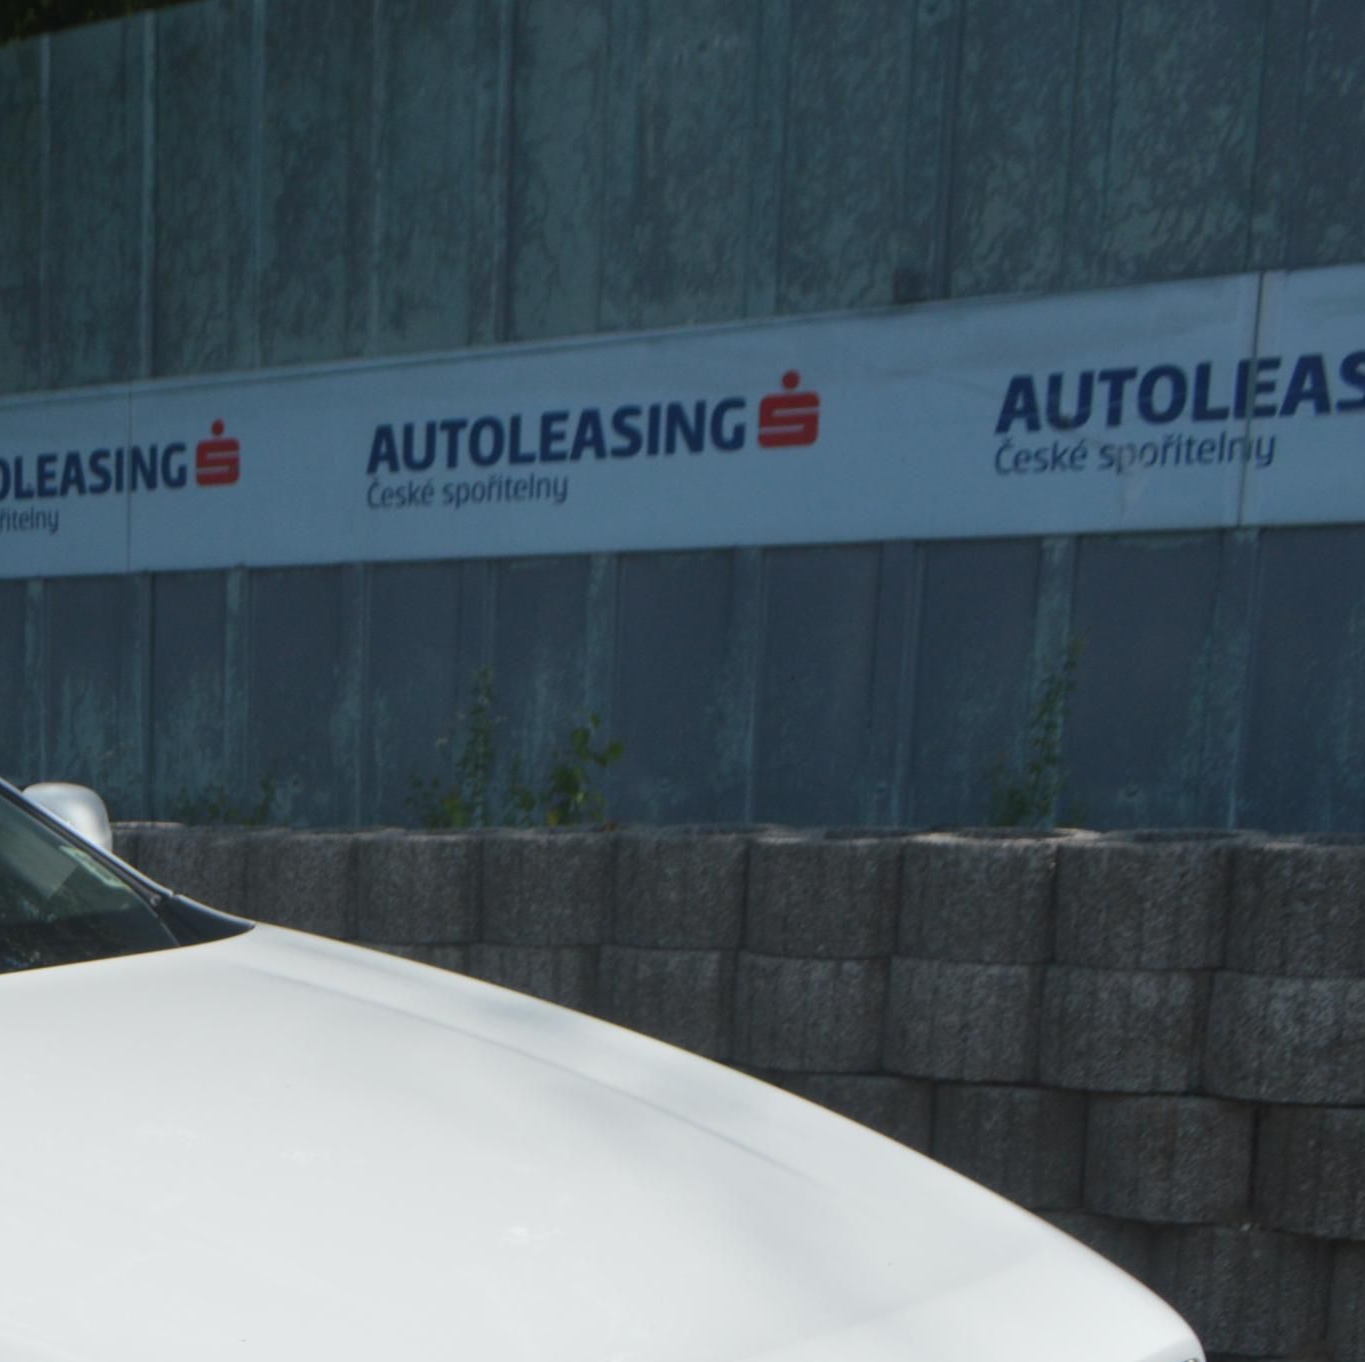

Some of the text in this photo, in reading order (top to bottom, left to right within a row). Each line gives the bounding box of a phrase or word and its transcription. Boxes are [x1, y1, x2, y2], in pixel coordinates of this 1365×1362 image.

[367, 397, 747, 475] AUTOLEASING
[995, 430, 1277, 476] České spořitelny
[367, 472, 569, 509] České spořitelny
